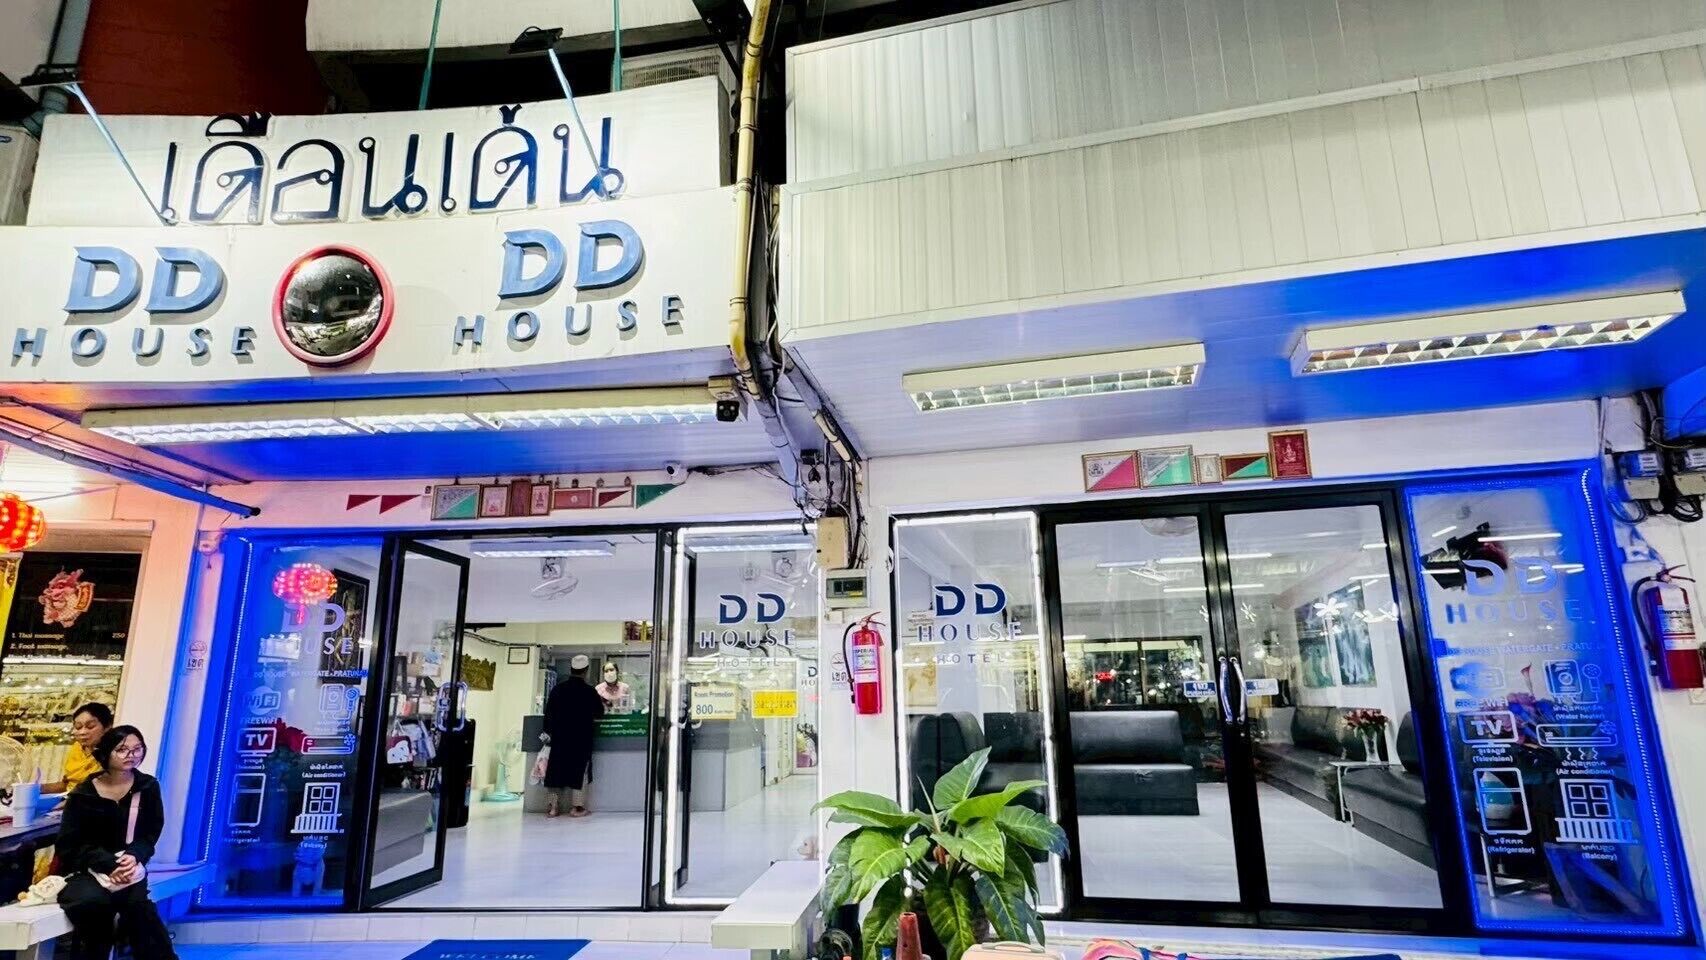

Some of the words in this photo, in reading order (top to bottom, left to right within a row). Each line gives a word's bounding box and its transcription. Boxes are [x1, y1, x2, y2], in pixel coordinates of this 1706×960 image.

[497, 219, 645, 301] DD
[63, 247, 225, 314] DD
[453, 294, 682, 347] HOUSE
[12, 326, 257, 358] HOUSE
[1462, 559, 1557, 597] DD
[719, 592, 786, 625] DD
[935, 583, 1006, 617] DD
[1445, 599, 1583, 624] HOUSE
[700, 628, 796, 649] HOUSE
[918, 622, 1022, 642] HOUSE
[938, 653, 1004, 664] HOTEL
[695, 704, 713, 715] 800
[246, 733, 269, 746] TV
[1471, 719, 1502, 736] TV
